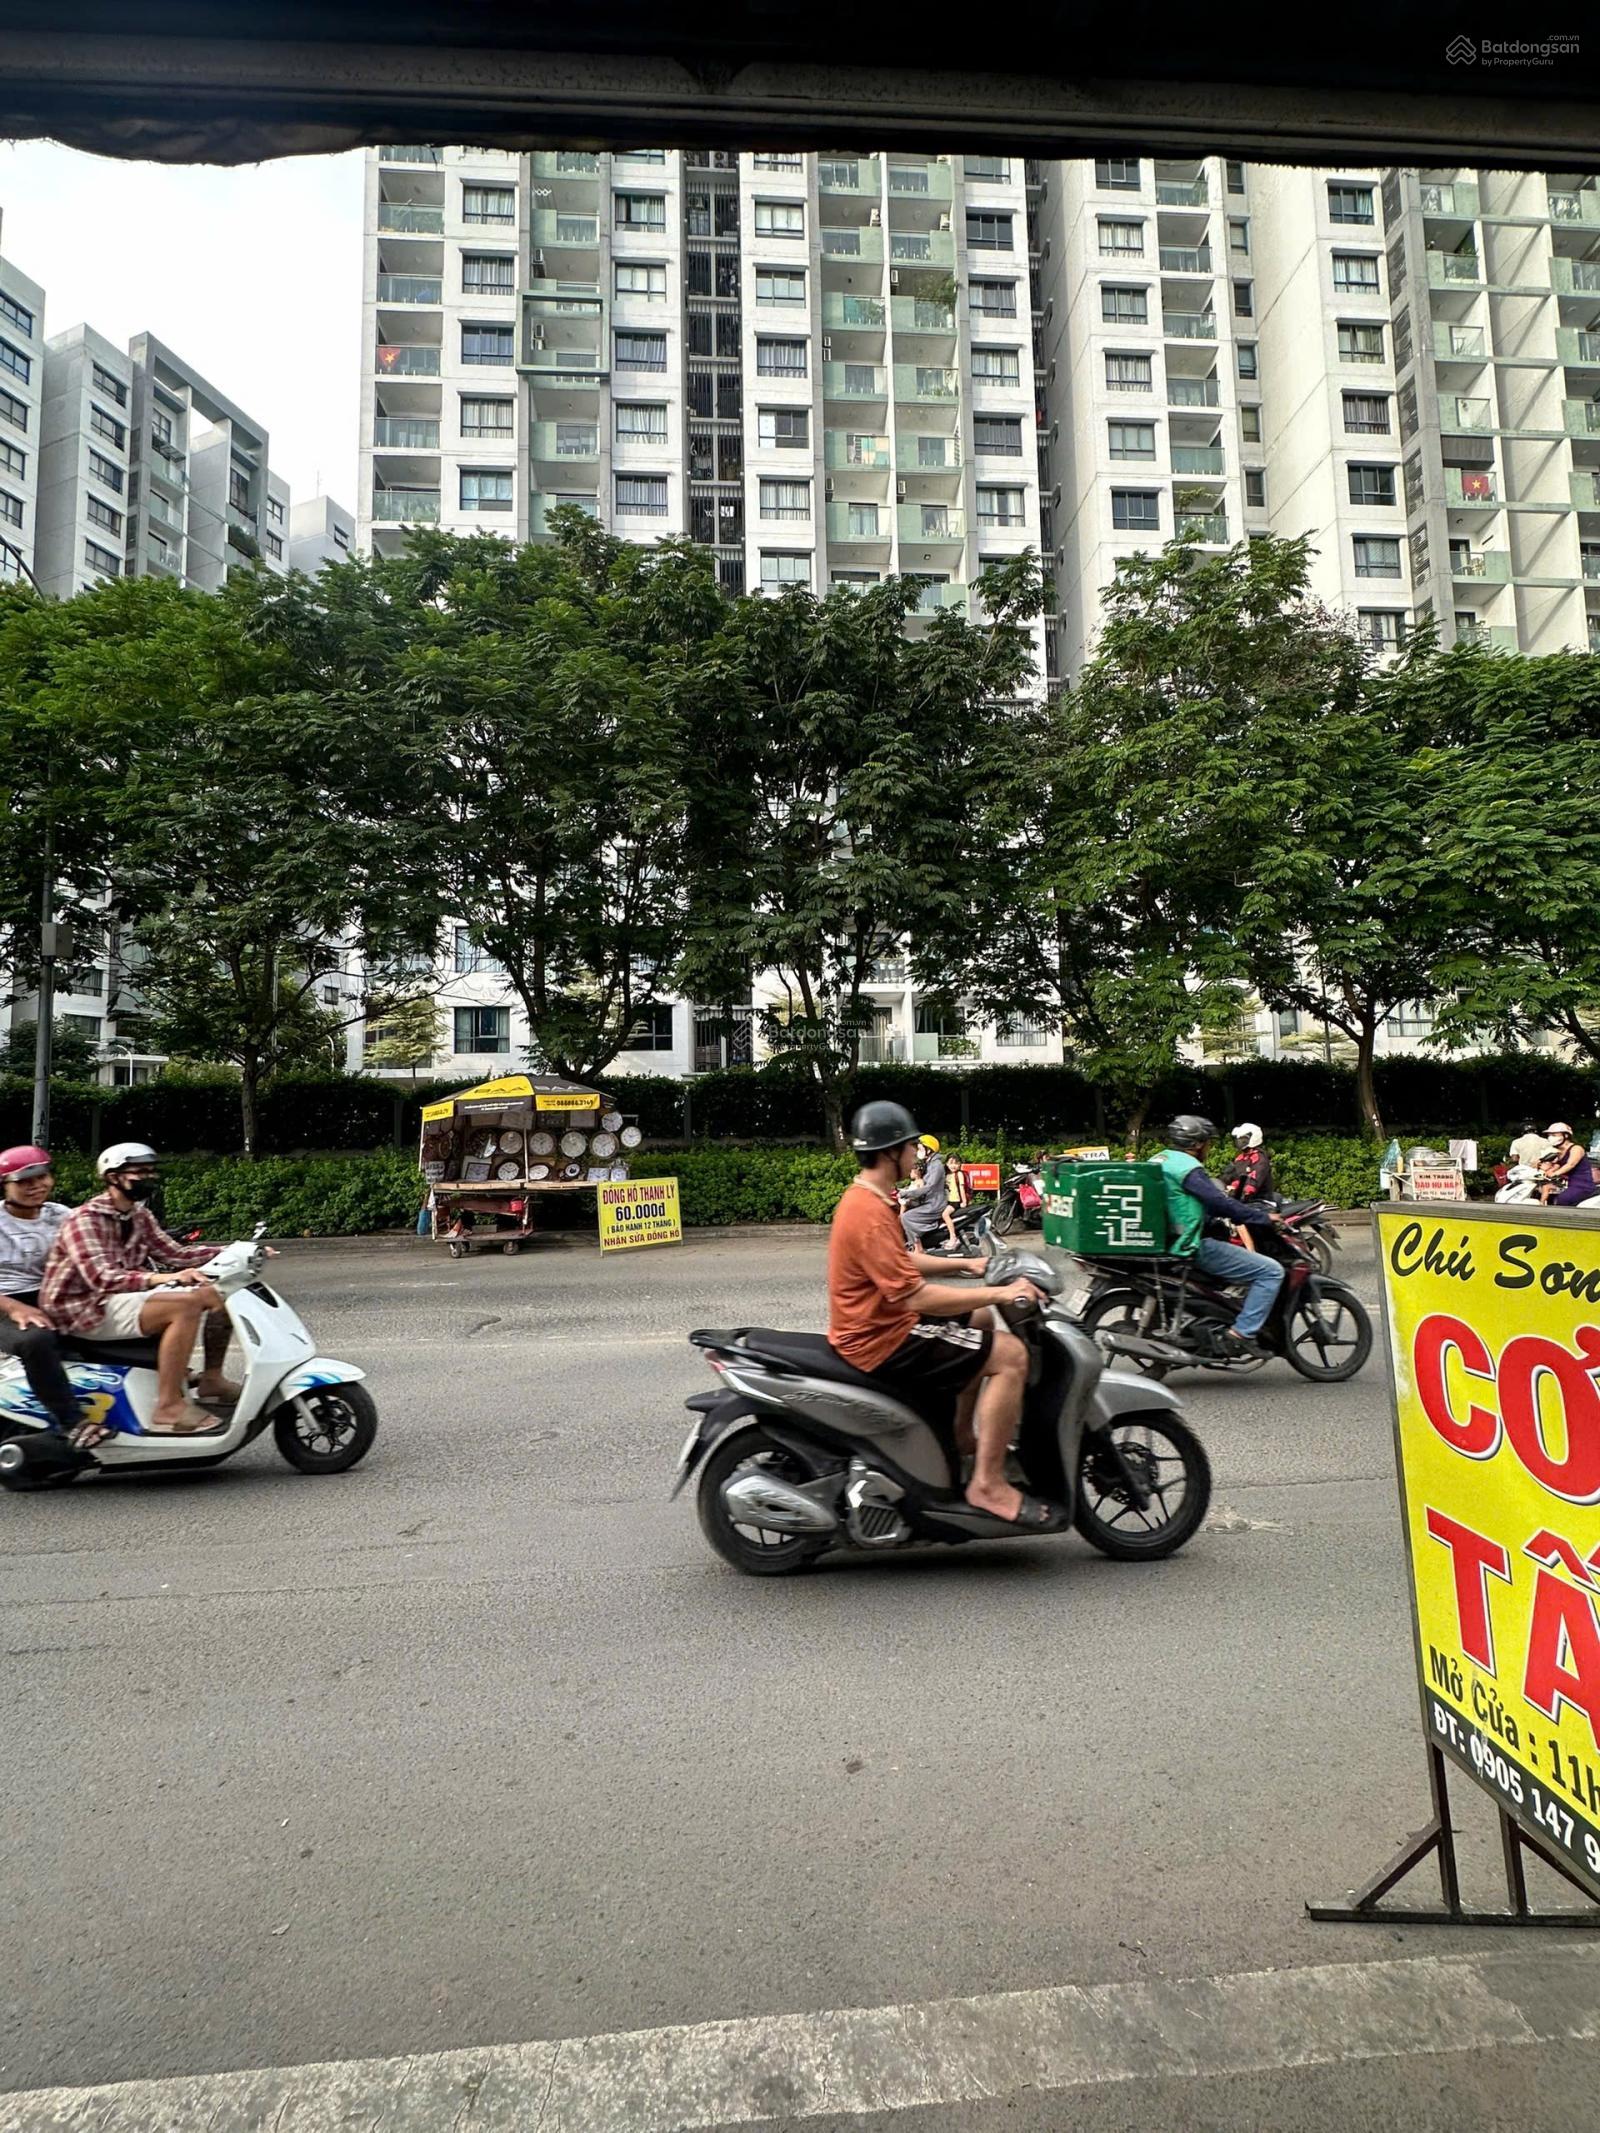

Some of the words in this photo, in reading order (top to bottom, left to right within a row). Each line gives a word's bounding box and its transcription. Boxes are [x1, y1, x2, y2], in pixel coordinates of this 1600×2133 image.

[640, 1185, 665, 1201] THANH
[666, 1181, 675, 1199] LÝ
[644, 1221, 651, 1230] 12
[1391, 1222, 1476, 1281] Chú
[1494, 1234, 1600, 1304] Sơn
[1429, 1644, 1463, 1702] Mở
[1471, 1679, 1520, 1751] Cửa
[1433, 1701, 1466, 1754] ĐT:
[1470, 1733, 1524, 1804] 0905
[1531, 1788, 1575, 1850] 147
